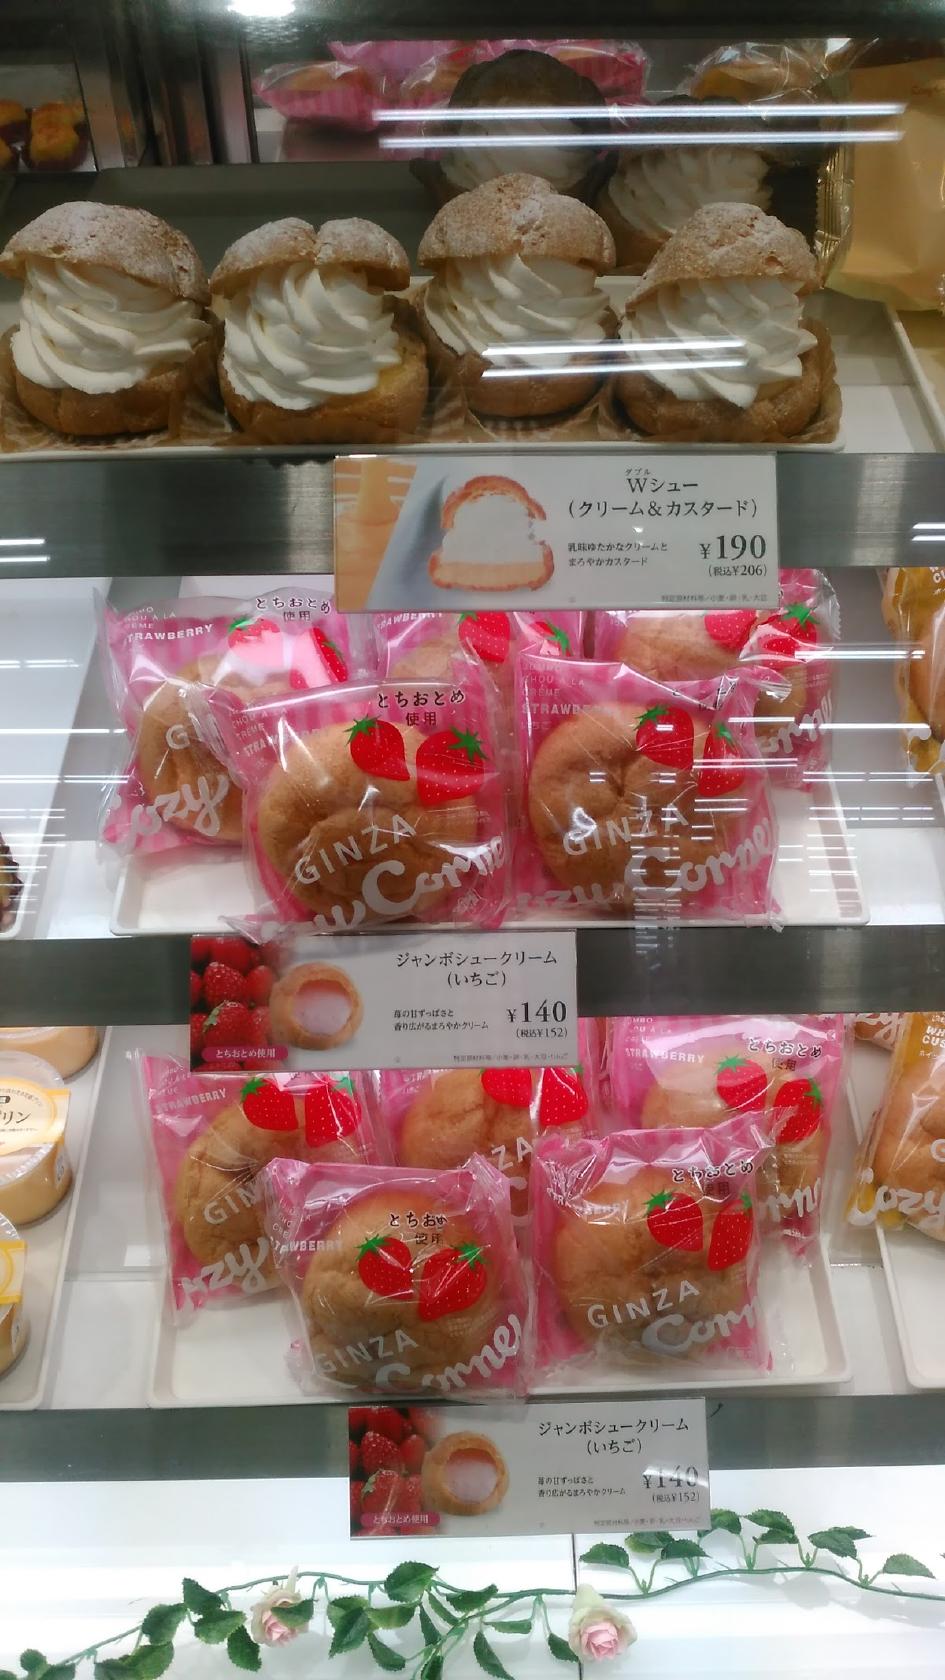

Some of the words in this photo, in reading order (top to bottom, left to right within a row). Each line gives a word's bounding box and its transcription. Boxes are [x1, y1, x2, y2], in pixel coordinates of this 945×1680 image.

[627, 478, 699, 493] Wシュー
[569, 499, 758, 518] (クリーム&カスタード)
[700, 534, 767, 561] ¥190
[708, 564, 768, 577] (税込¥206)
[256, 596, 331, 614] とちおとめ
[127, 623, 214, 643] TRAWBERRY
[377, 689, 465, 709] とちおとめ
[405, 712, 438, 726] 使用
[562, 803, 690, 857] GINZA
[295, 814, 417, 885] GINZA
[395, 951, 558, 968] ジャンボシュークリーム
[447, 971, 507, 989] (いちご)
[506, 999, 568, 1023] ¥140
[216, 1047, 276, 1059] とちおとめ使用
[748, 1038, 823, 1059] とちおとめ
[587, 1279, 700, 1329] GINZA
[314, 1329, 420, 1375] GINZA
[538, 1418, 689, 1436] ジャンボシュークリーム
[586, 1438, 642, 1455] (いちご)
[642, 1465, 699, 1489] ¥140
